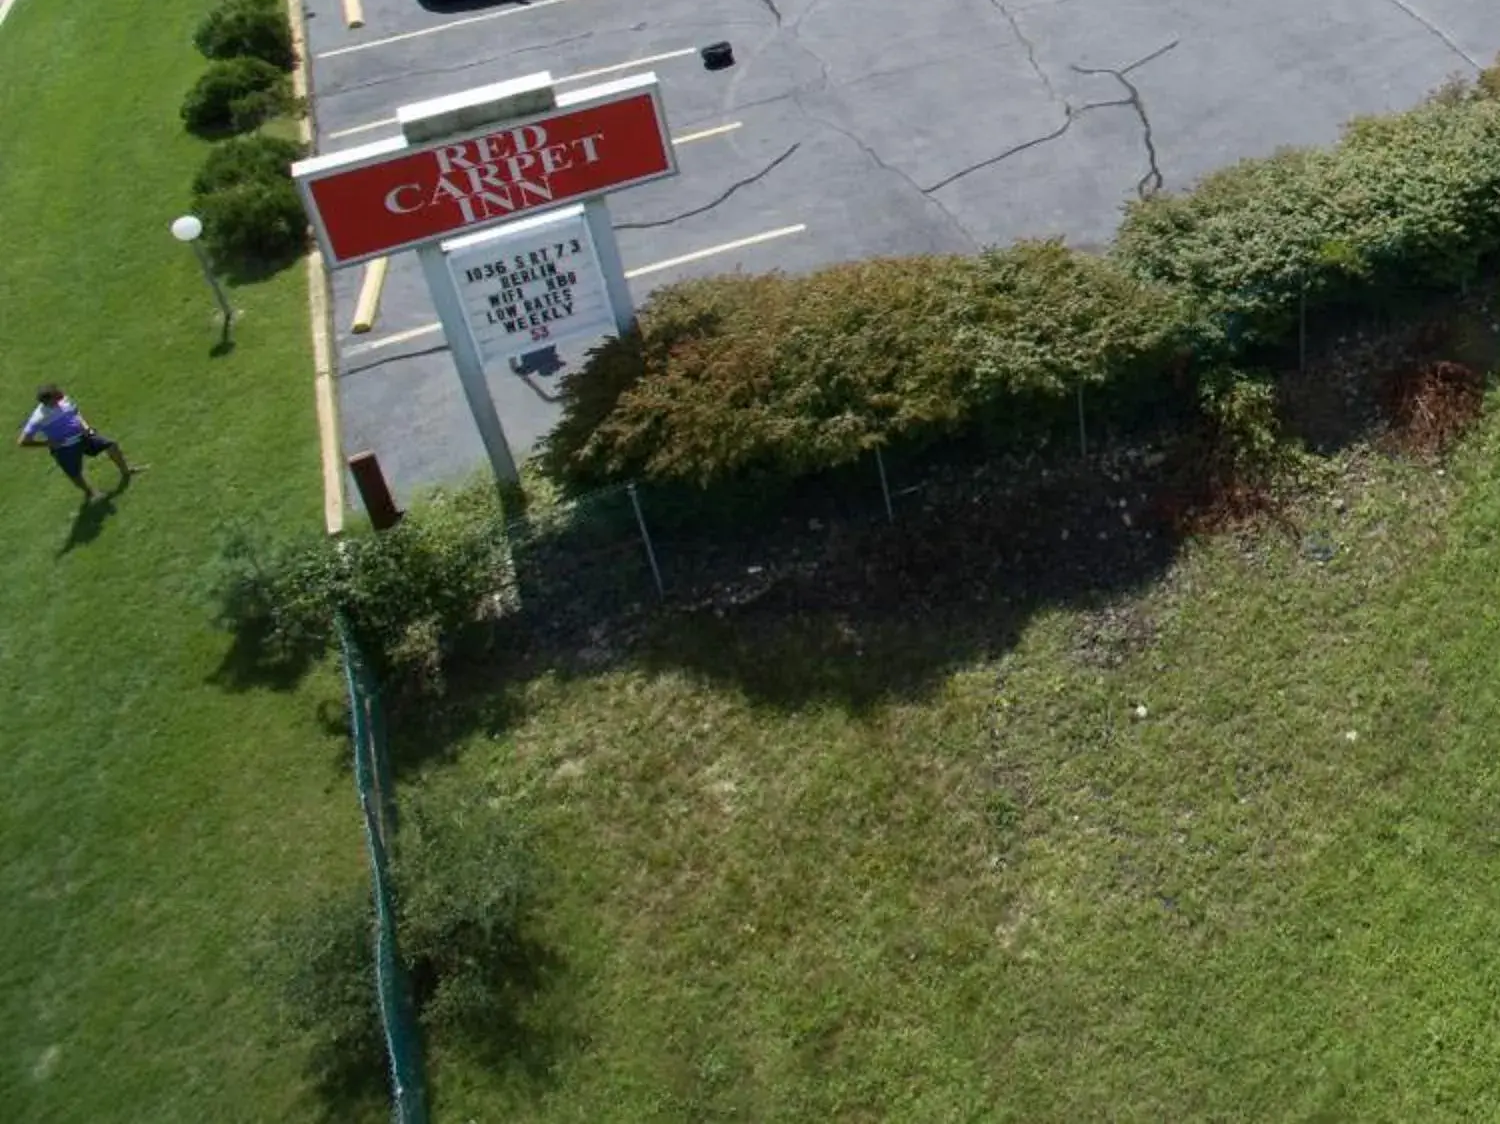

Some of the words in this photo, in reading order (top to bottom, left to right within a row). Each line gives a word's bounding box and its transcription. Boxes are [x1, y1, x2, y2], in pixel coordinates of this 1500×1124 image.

[432, 123, 549, 174] RED
[384, 133, 605, 214] CARPET
[455, 175, 553, 224] INN
[465, 260, 507, 283] 1036
[514, 255, 525, 269] S
[528, 247, 549, 266] RT
[500, 262, 557, 289] BERLIN
[486, 305, 518, 325] LOW
[523, 288, 573, 314] RATES
[488, 288, 524, 308] WIFI
[503, 302, 574, 334] WEEKLY
